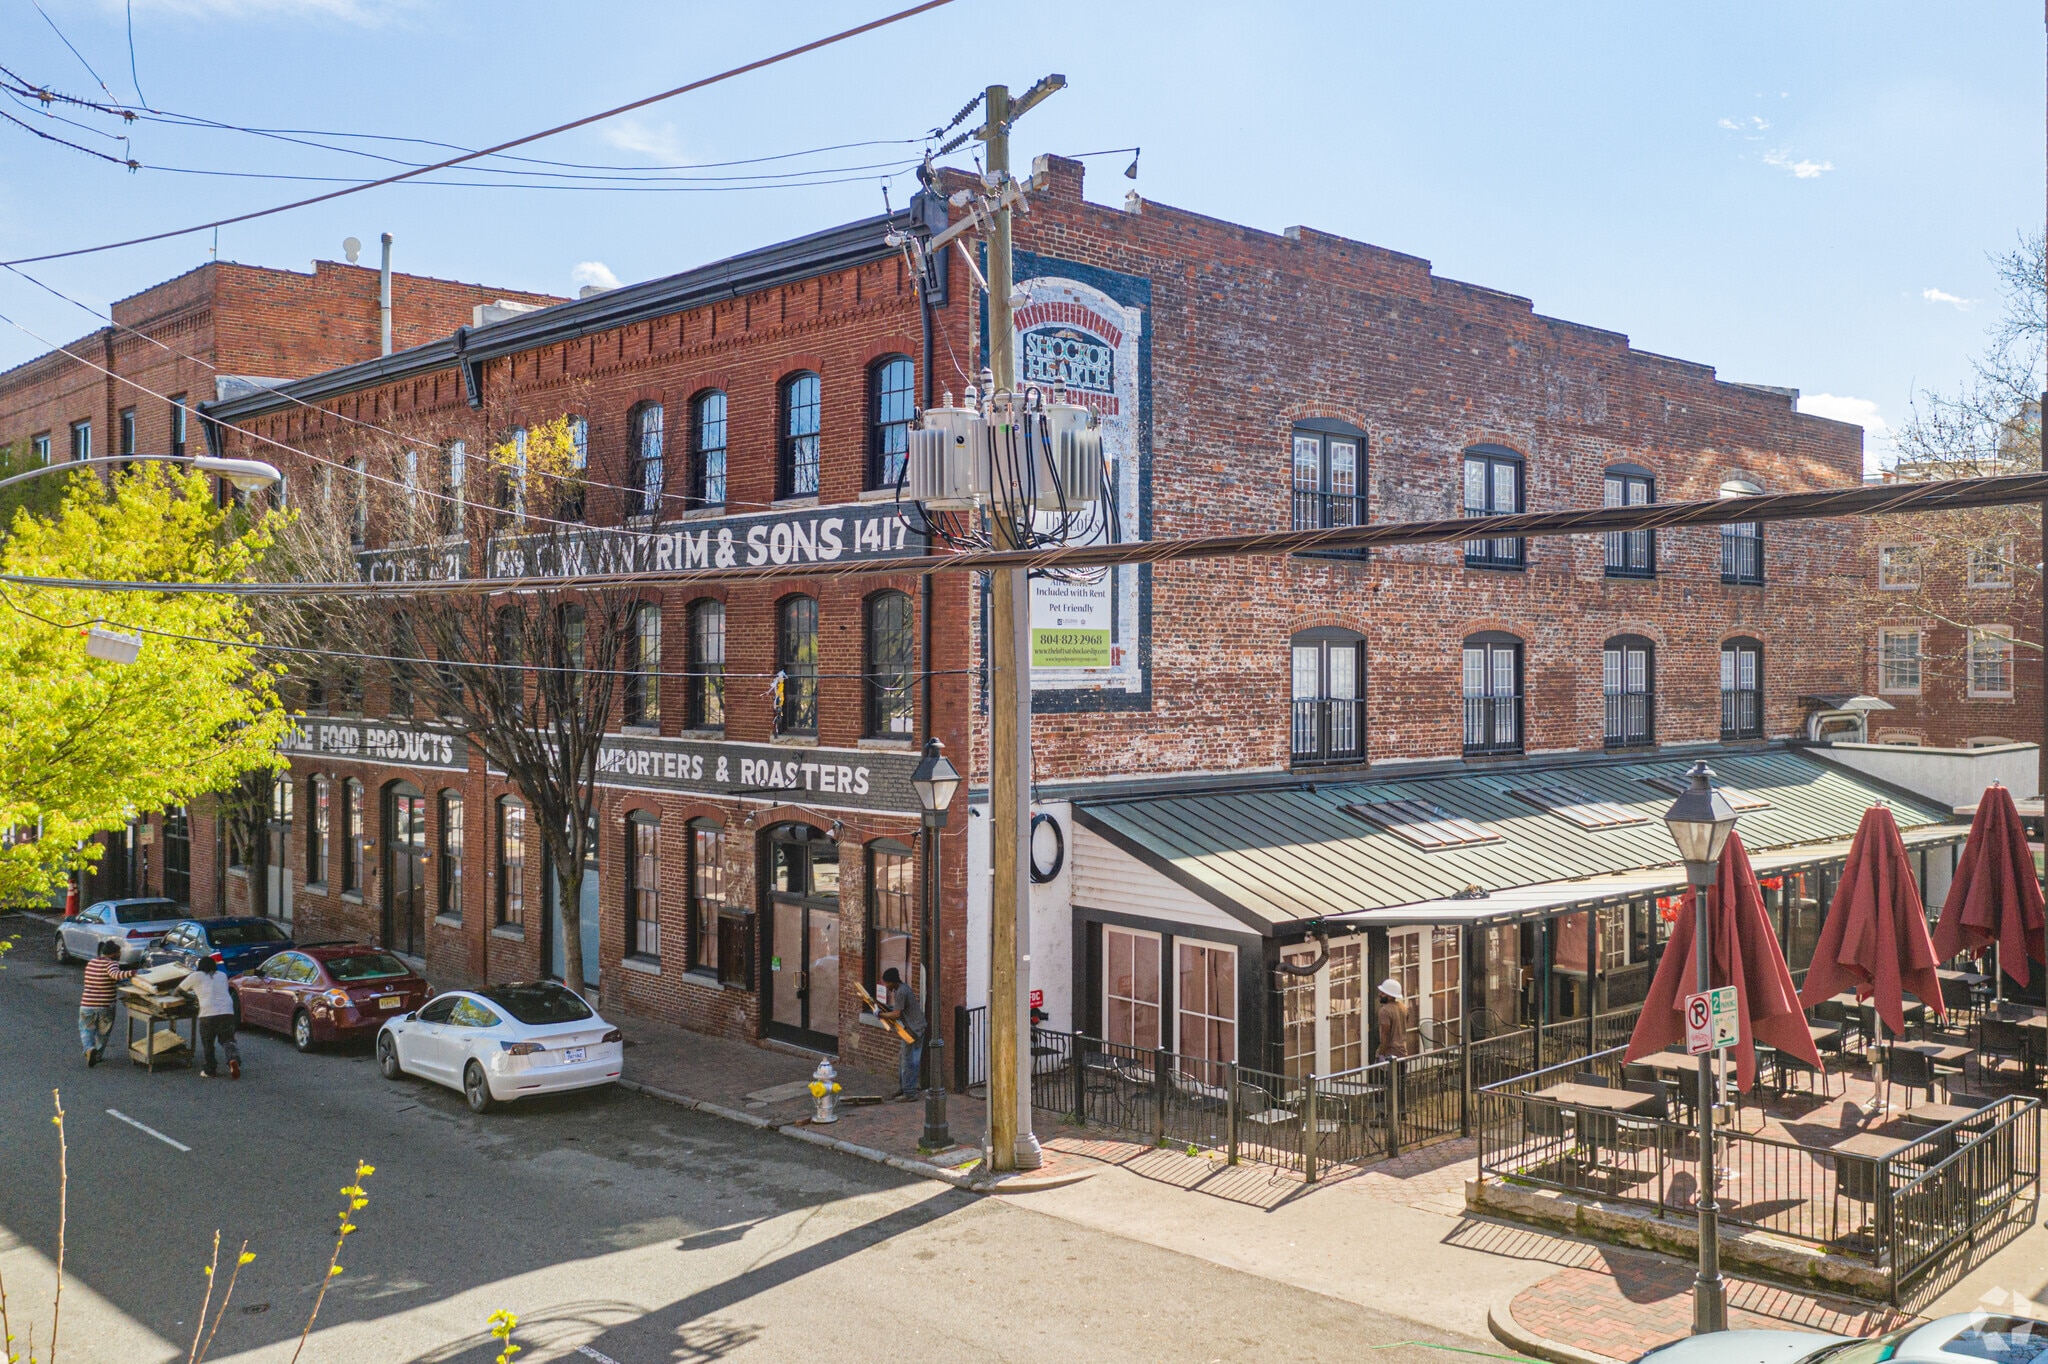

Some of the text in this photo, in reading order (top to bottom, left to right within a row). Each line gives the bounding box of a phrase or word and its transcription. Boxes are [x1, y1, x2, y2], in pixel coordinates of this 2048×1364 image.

[1026, 333, 1111, 368] SHOCKOE
[714, 527, 737, 569] &
[746, 517, 845, 567] SONS
[853, 515, 911, 554] 1417
[1036, 587, 1106, 598] Included with Rent
[1049, 603, 1094, 614] Pet Friendly
[319, 725, 360, 755] FOOD
[366, 728, 453, 765] PRODUCTS
[716, 755, 730, 783] &
[740, 758, 870, 795] ROASTERS
[1713, 997, 1719, 1011] 2
